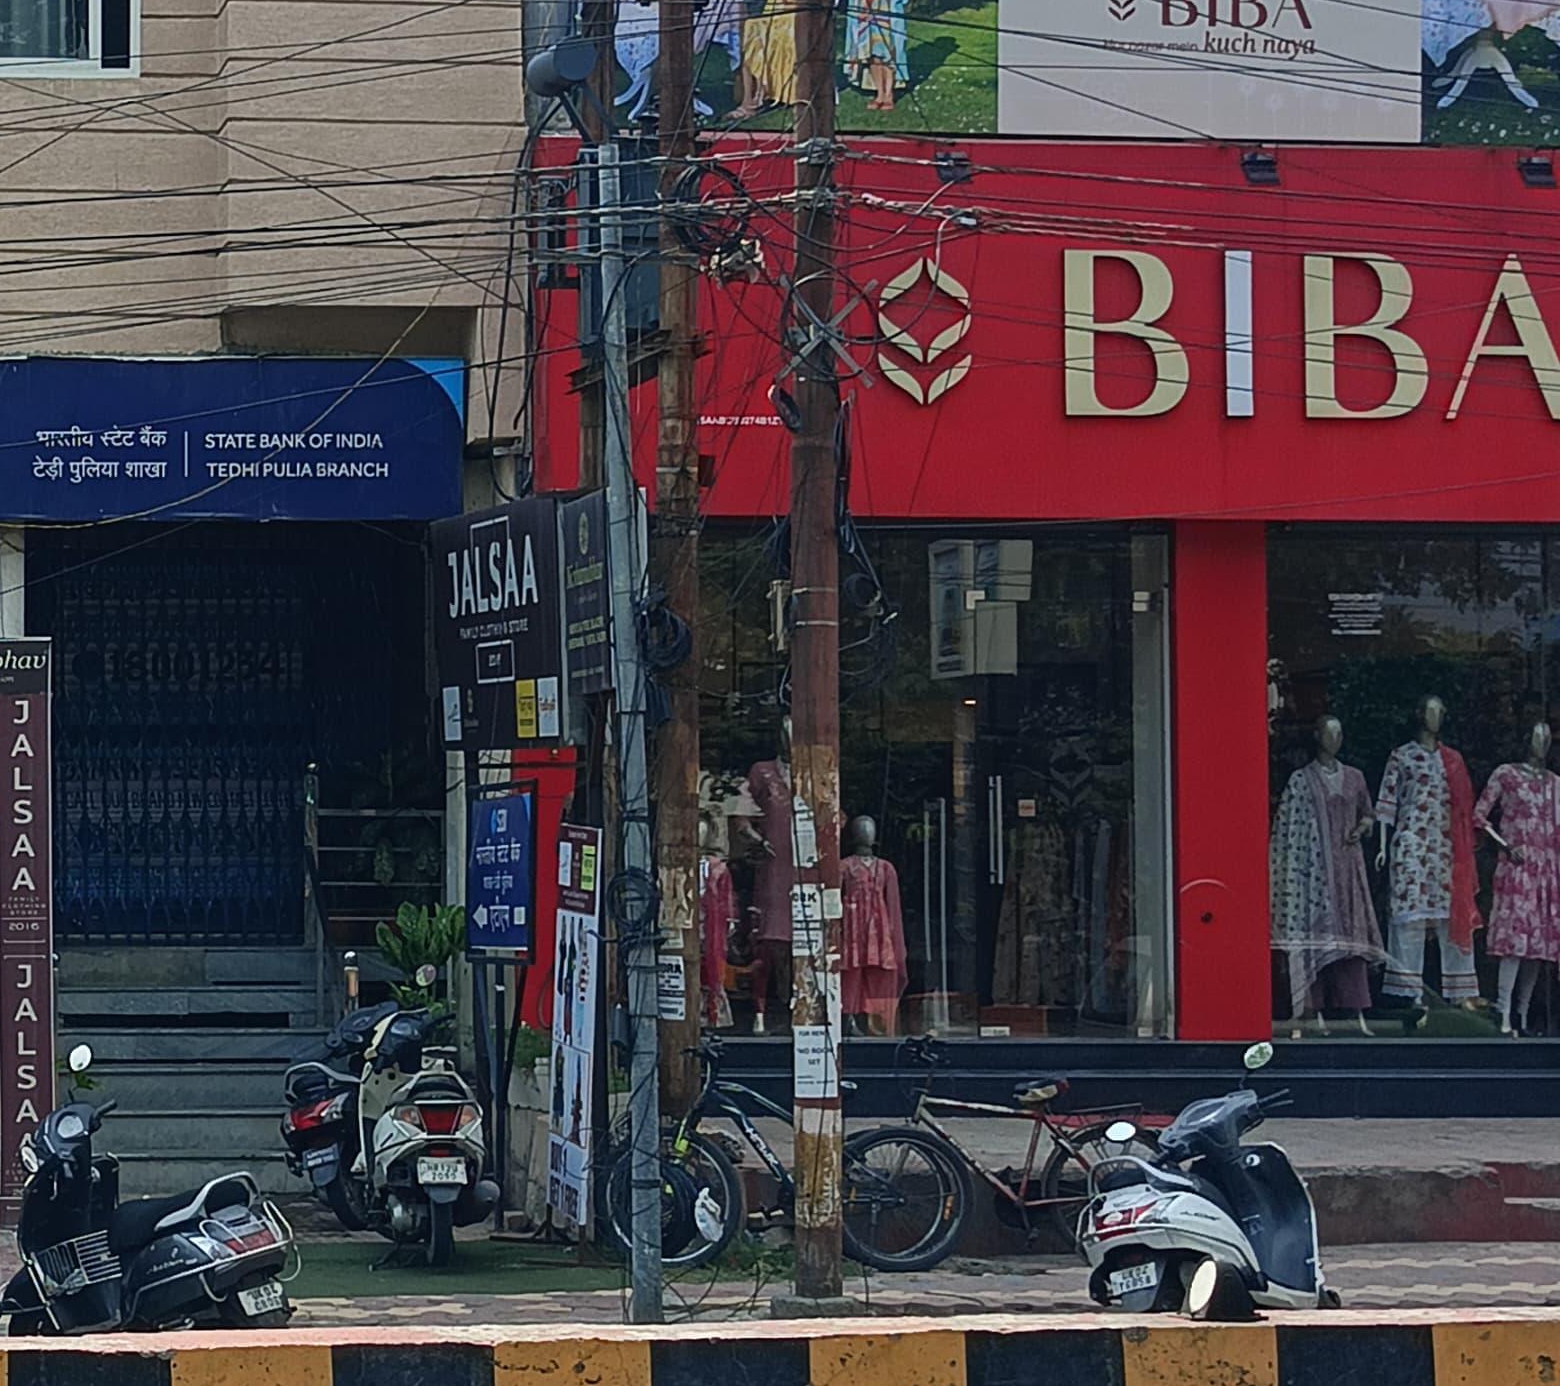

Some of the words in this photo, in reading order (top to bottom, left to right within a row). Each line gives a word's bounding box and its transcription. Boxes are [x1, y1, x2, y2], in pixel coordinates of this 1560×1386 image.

[1204, 31, 1256, 54] kuch
[1263, 37, 1316, 61] naya
[1062, 248, 1560, 421] BIBA
[100, 424, 136, 447] स्टेट
[139, 425, 168, 447] बैंक
[204, 434, 256, 449] STATE
[259, 434, 305, 449] BANK
[309, 434, 333, 449] OF
[336, 434, 384, 449] INDIA
[69, 456, 120, 483] पुलिया
[125, 461, 168, 478] शाखा
[206, 462, 260, 478] TEDHI
[263, 462, 313, 478] PULIA
[316, 462, 389, 478] BRANCH
[448, 534, 538, 618] JALSAA
[11, 700, 36, 891] JALSAA
[8, 922, 40, 931] 2016
